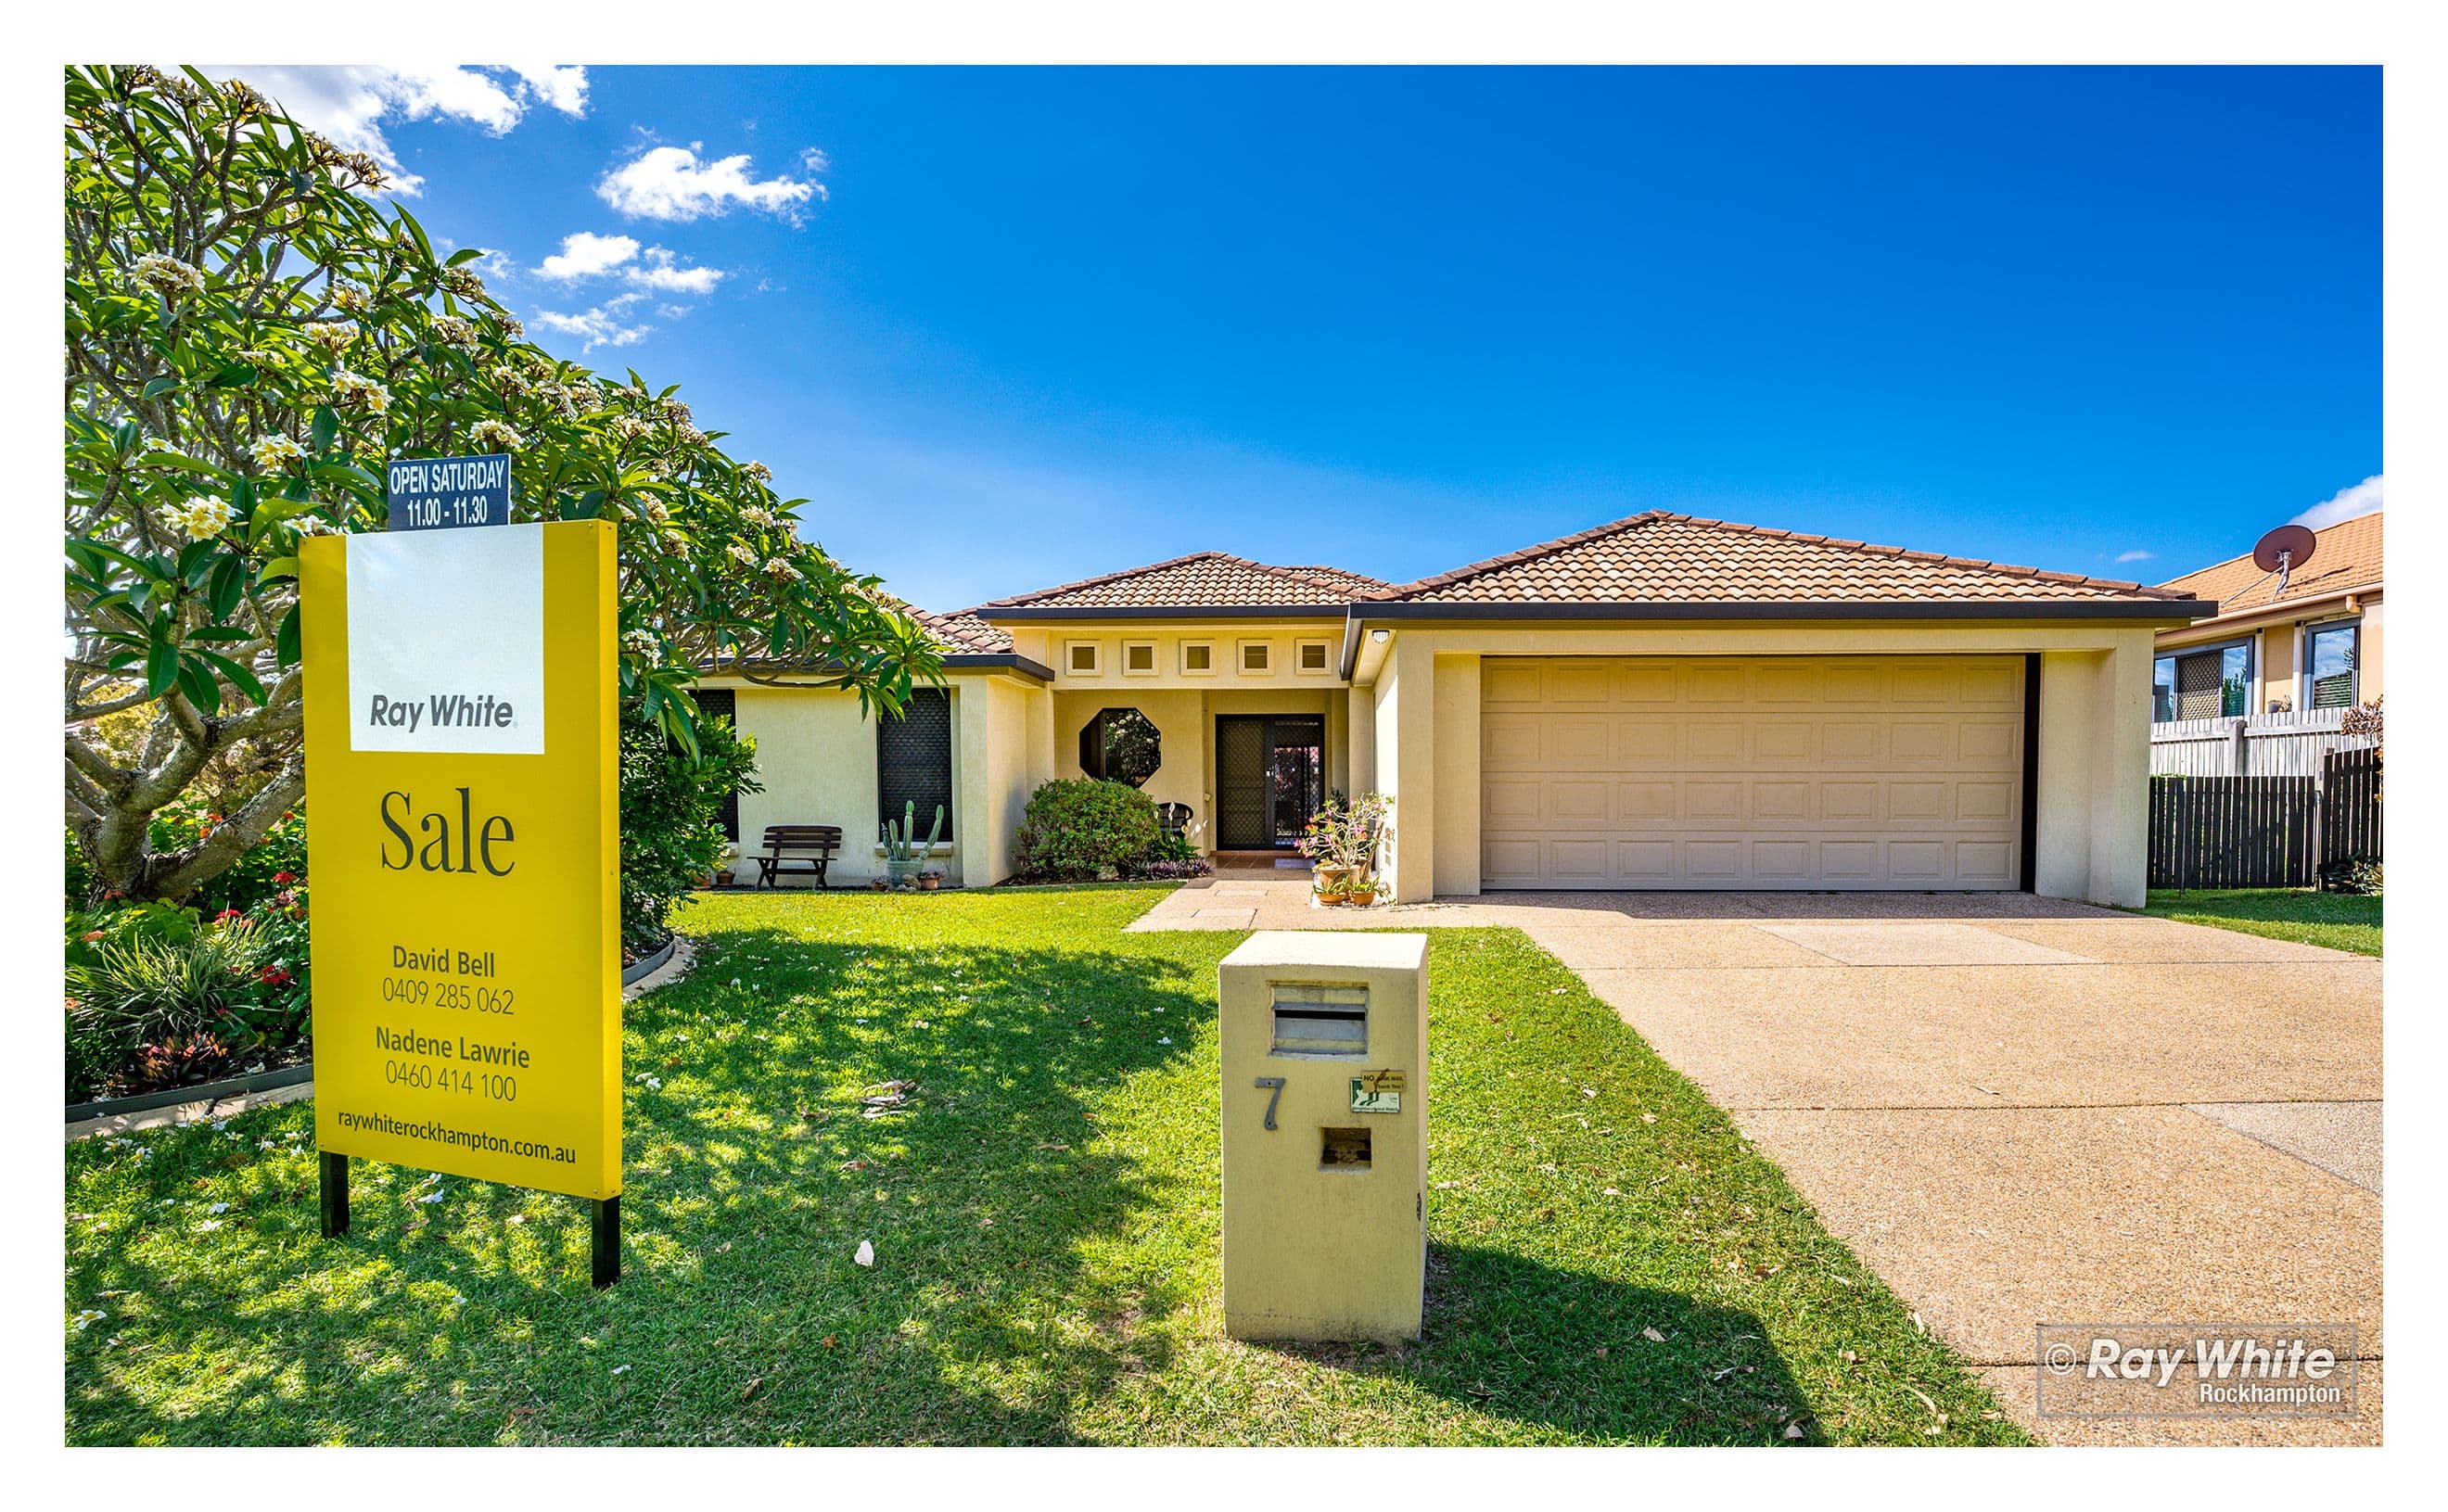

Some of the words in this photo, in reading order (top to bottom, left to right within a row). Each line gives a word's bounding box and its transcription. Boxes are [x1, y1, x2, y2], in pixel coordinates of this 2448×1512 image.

[390, 464, 428, 495] OPEN
[431, 460, 505, 493] SATURDAY
[407, 499, 440, 527] 11.00
[453, 495, 488, 525] 11.30
[370, 694, 424, 733] Ray
[430, 694, 513, 728] White
[380, 787, 516, 877] Sale
[392, 944, 450, 974] David
[457, 950, 495, 978] Bell
[382, 976, 429, 1006] 0409
[435, 983, 471, 1010] 285
[477, 988, 515, 1016] 062
[376, 1025, 453, 1058] Nadene
[459, 1036, 530, 1069] Lawrie
[386, 1060, 432, 1090] 0460
[437, 1066, 474, 1096] 414
[480, 1073, 517, 1102] 100
[1255, 1076, 1286, 1131] 7
[337, 1111, 577, 1165] raywhiterockhampton.com.au
